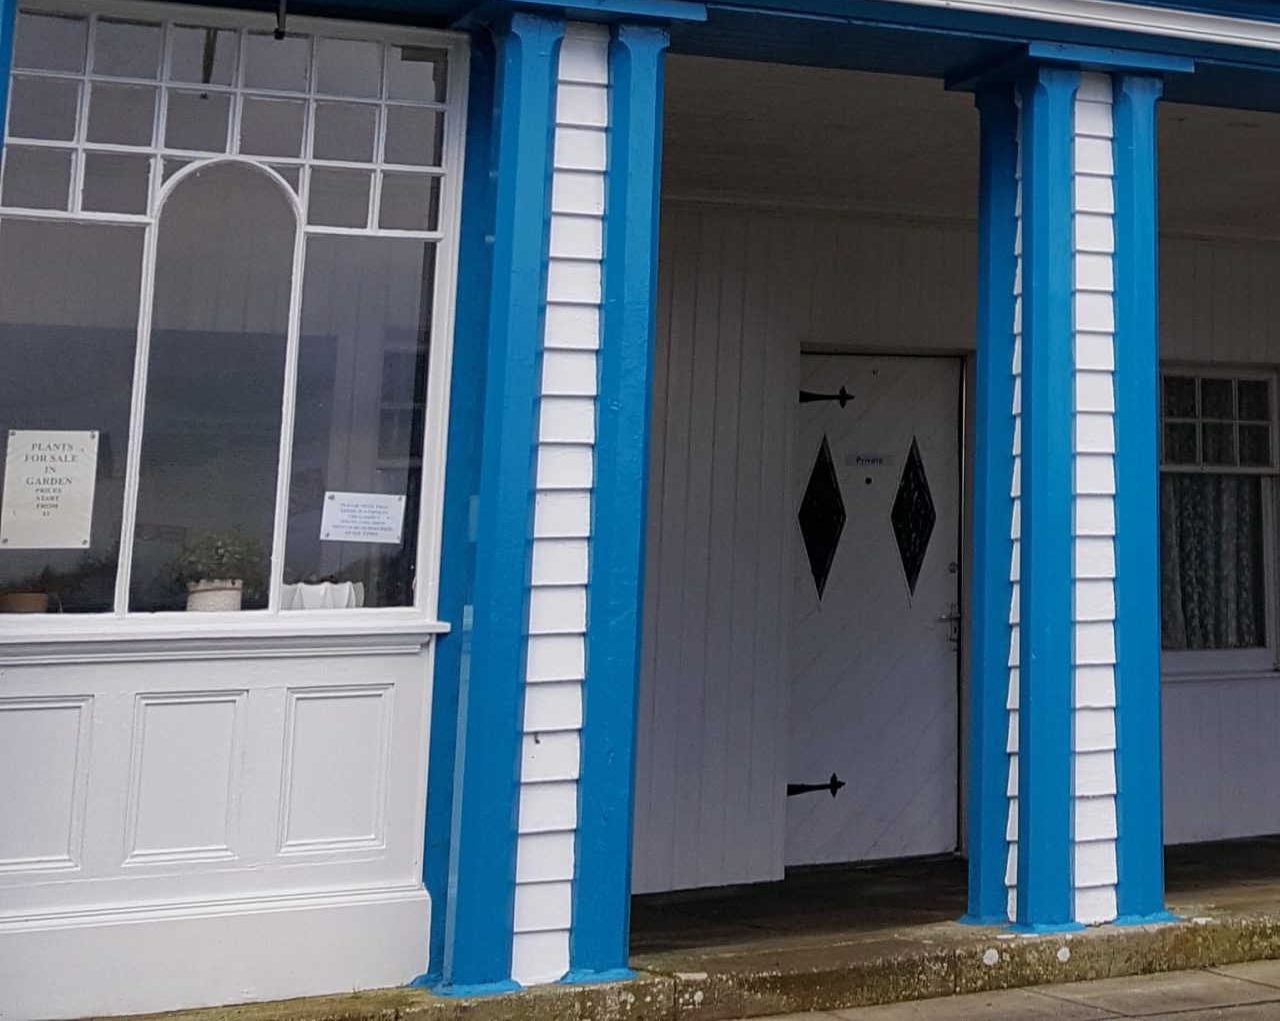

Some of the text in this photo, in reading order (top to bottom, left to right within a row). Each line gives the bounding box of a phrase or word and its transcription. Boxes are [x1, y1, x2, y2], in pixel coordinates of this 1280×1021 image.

[31, 443, 74, 452] PLANTS
[24, 454, 79, 463] FOR SALE
[855, 456, 882, 464] Private
[44, 466, 57, 474] IN
[25, 477, 72, 486] GARDEN
